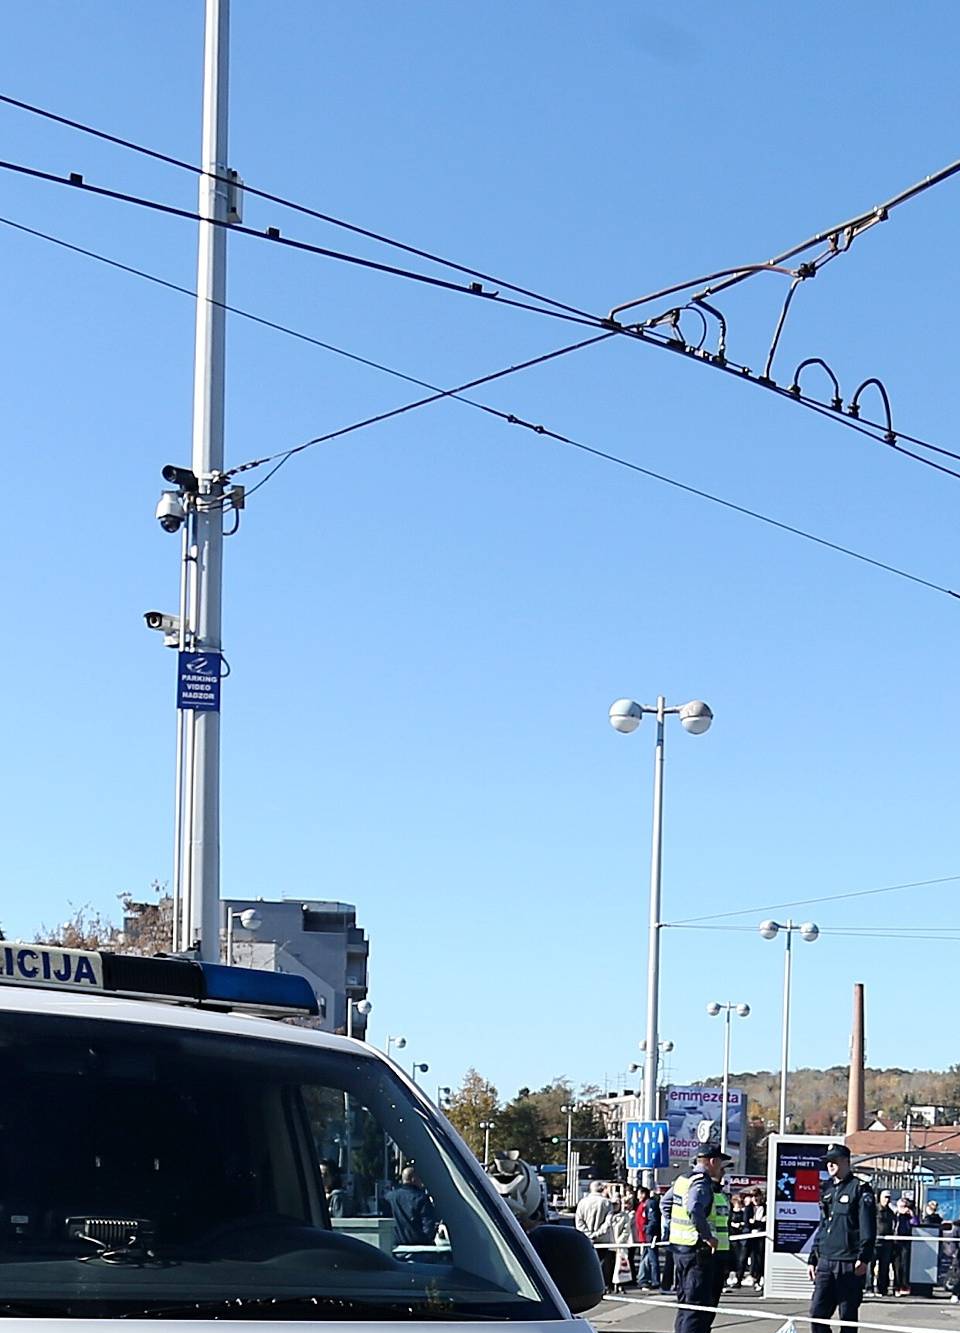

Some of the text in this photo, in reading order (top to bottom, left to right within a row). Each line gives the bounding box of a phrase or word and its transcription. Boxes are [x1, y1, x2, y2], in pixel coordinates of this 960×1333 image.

[182, 674, 217, 683] PARKING
[186, 683, 211, 691] VIDEO
[182, 691, 214, 700] NADZOR
[0, 946, 97, 985] ICIJA
[779, 1207, 797, 1215] PULS
